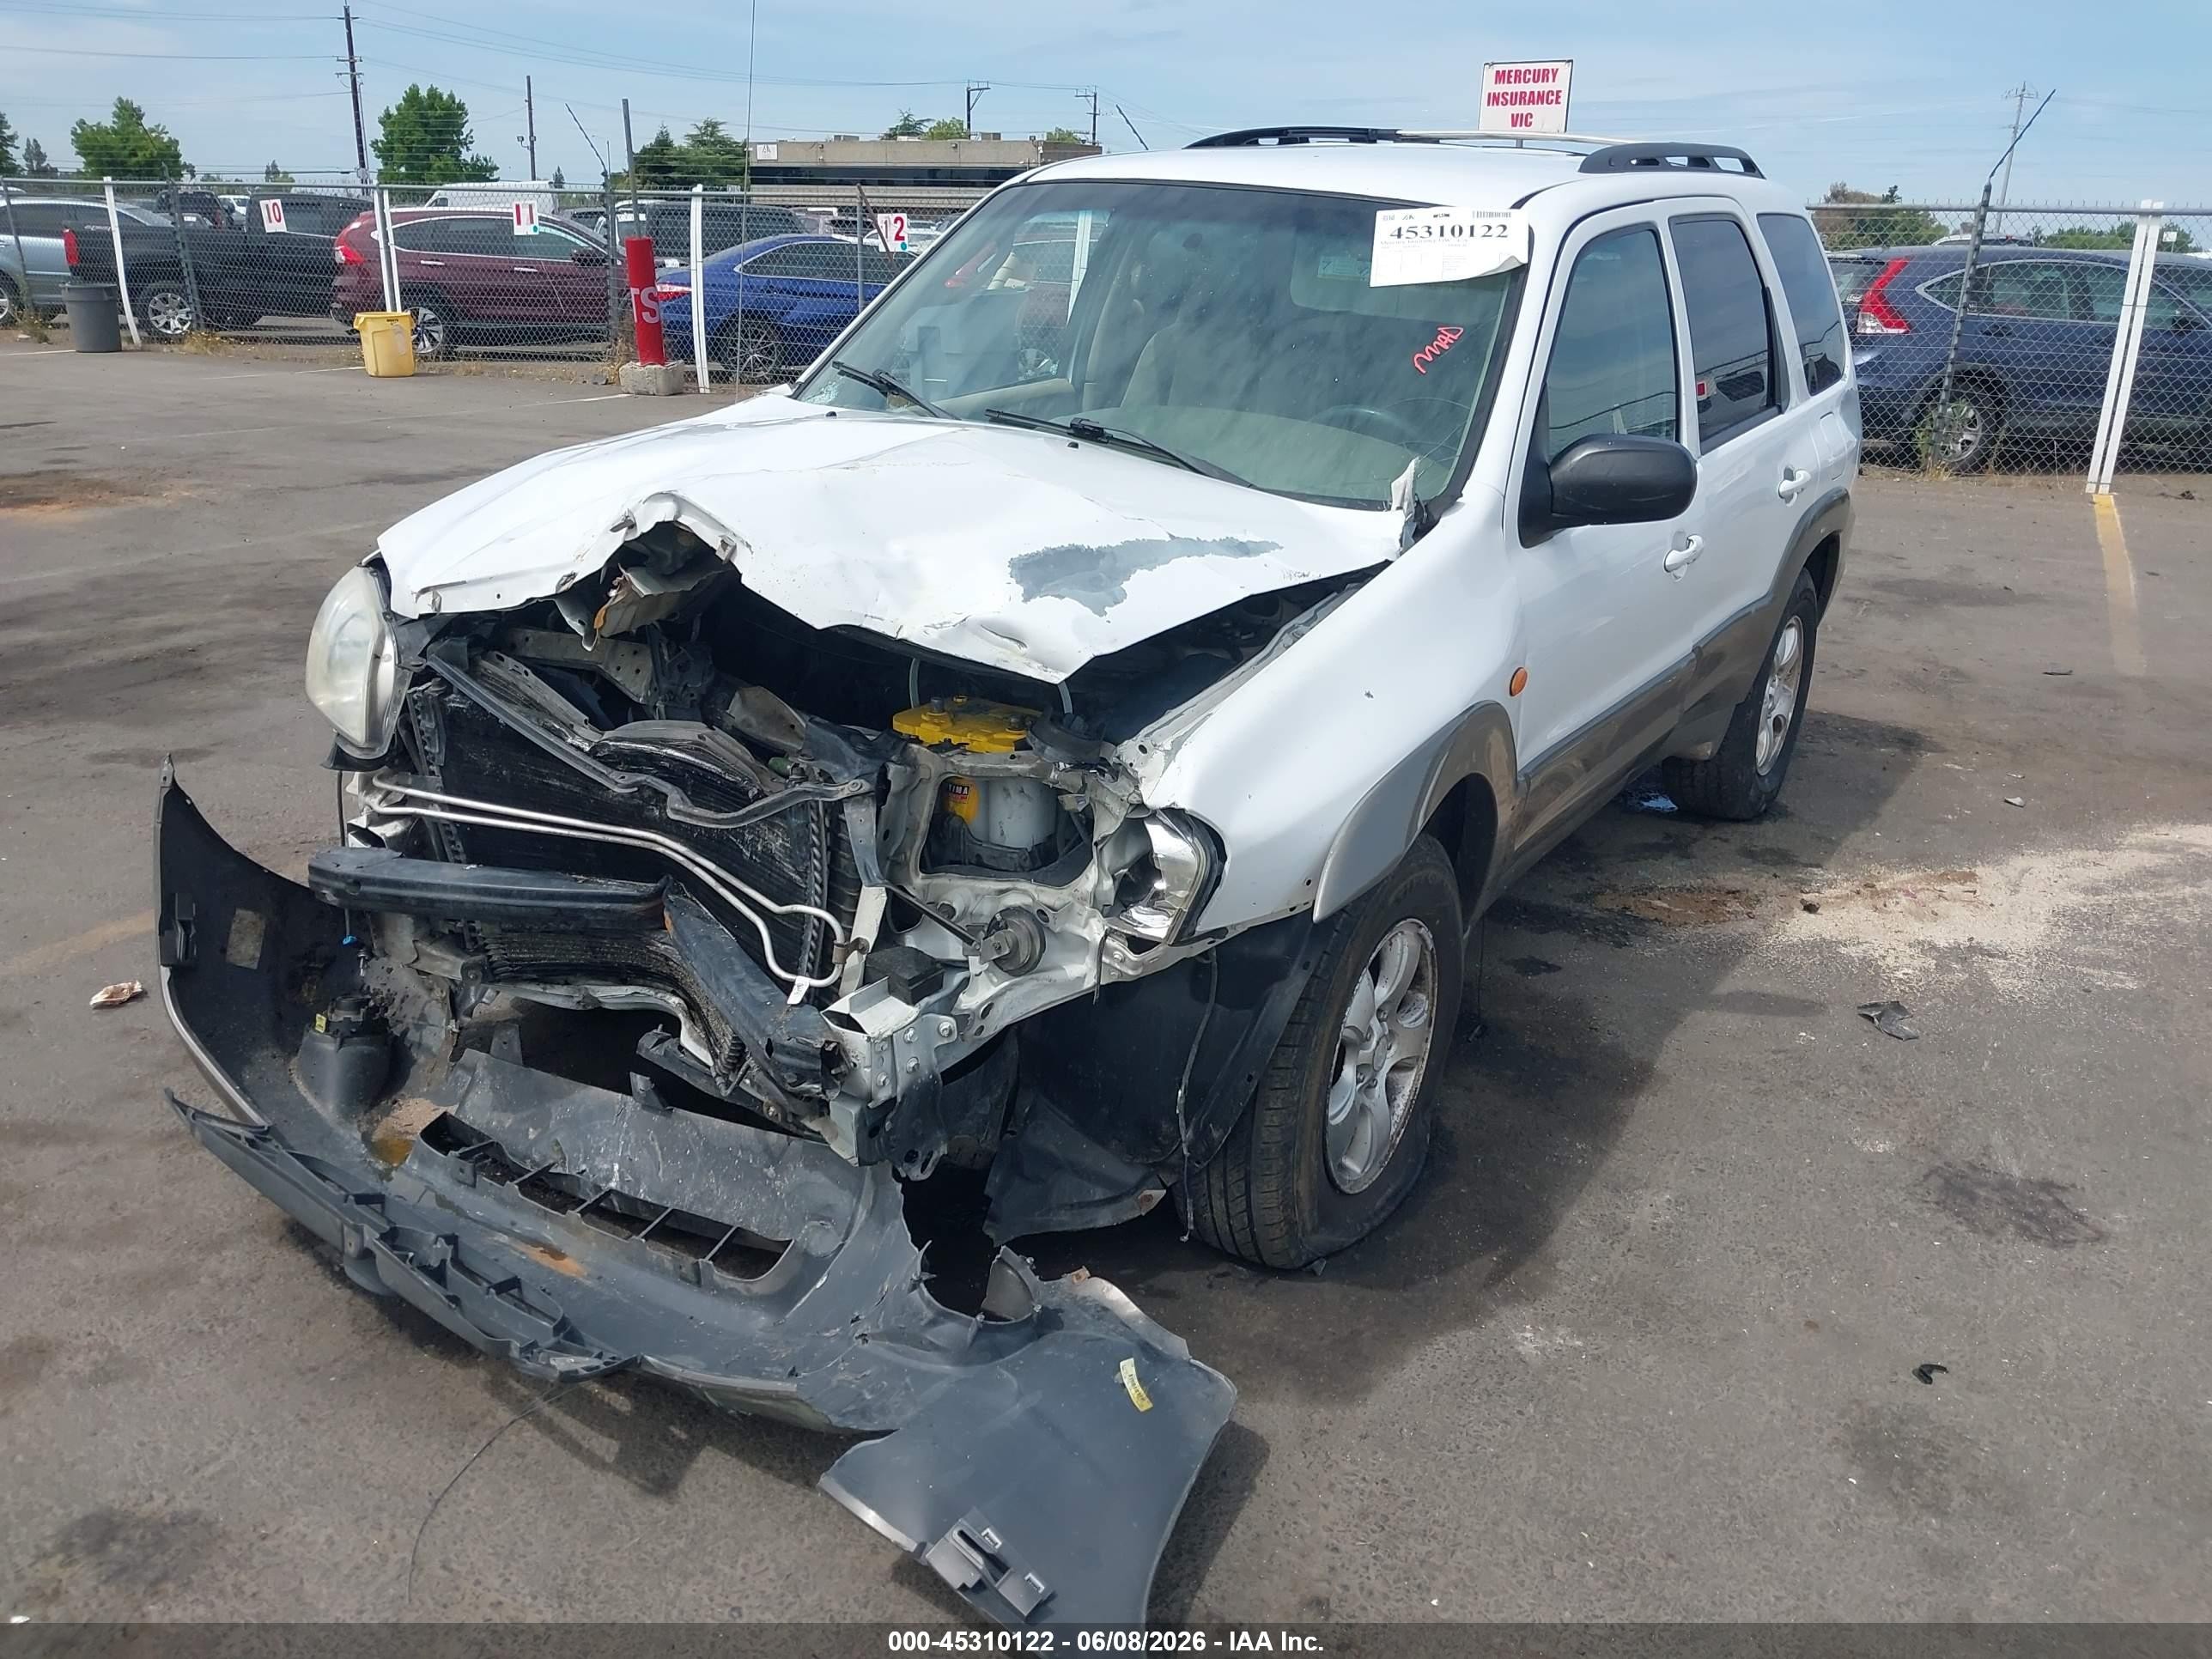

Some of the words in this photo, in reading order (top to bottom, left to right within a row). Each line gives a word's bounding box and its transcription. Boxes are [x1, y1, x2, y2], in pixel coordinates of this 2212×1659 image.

[1494, 68, 1559, 85] MERCURY
[1486, 90, 1563, 106] INSURANCE
[1510, 112, 1534, 128] VIC
[265, 202, 282, 223] 10
[515, 204, 534, 226] 11
[884, 216, 905, 241] 12
[1389, 224, 1509, 240] 45310122
